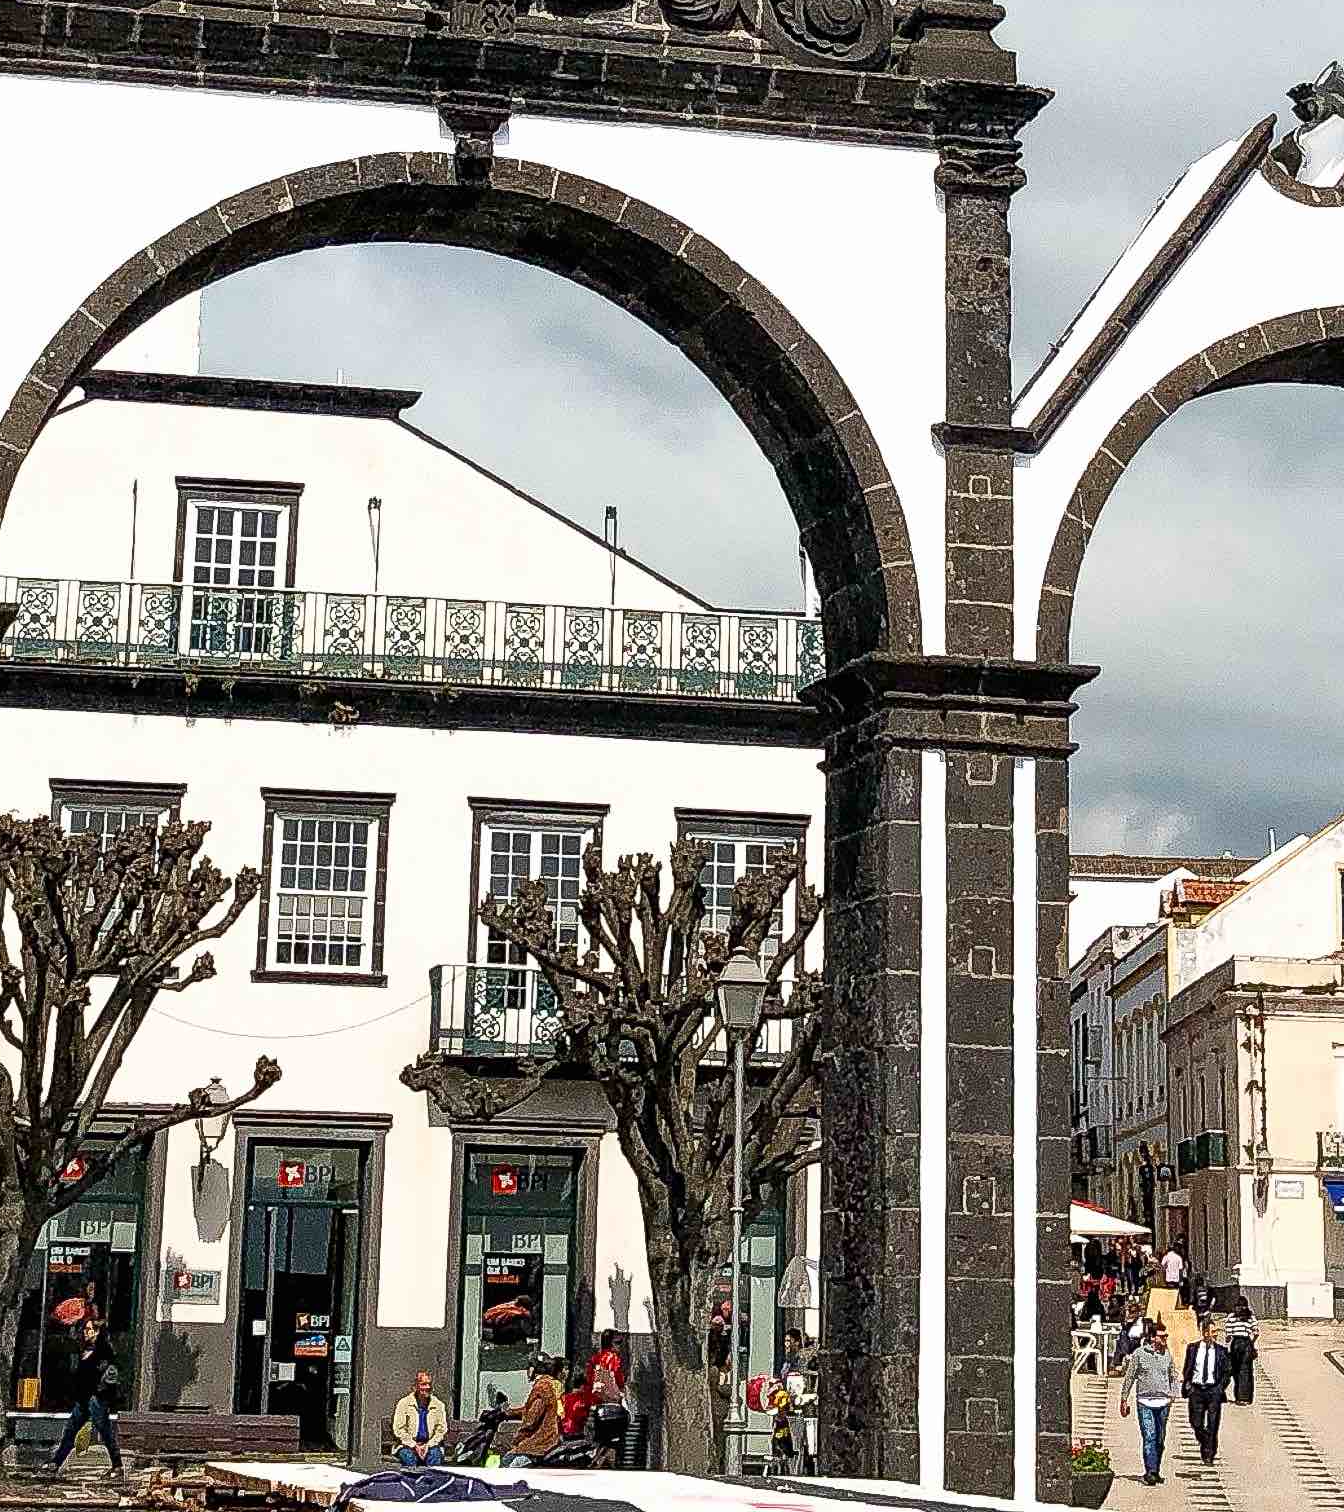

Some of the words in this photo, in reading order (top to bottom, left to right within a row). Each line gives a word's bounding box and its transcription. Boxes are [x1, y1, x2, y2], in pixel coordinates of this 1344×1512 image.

[304, 1165, 336, 1185] BPI
[519, 1173, 548, 1191] BPI
[191, 1273, 214, 1288] BPI
[310, 1314, 330, 1328] BPI
